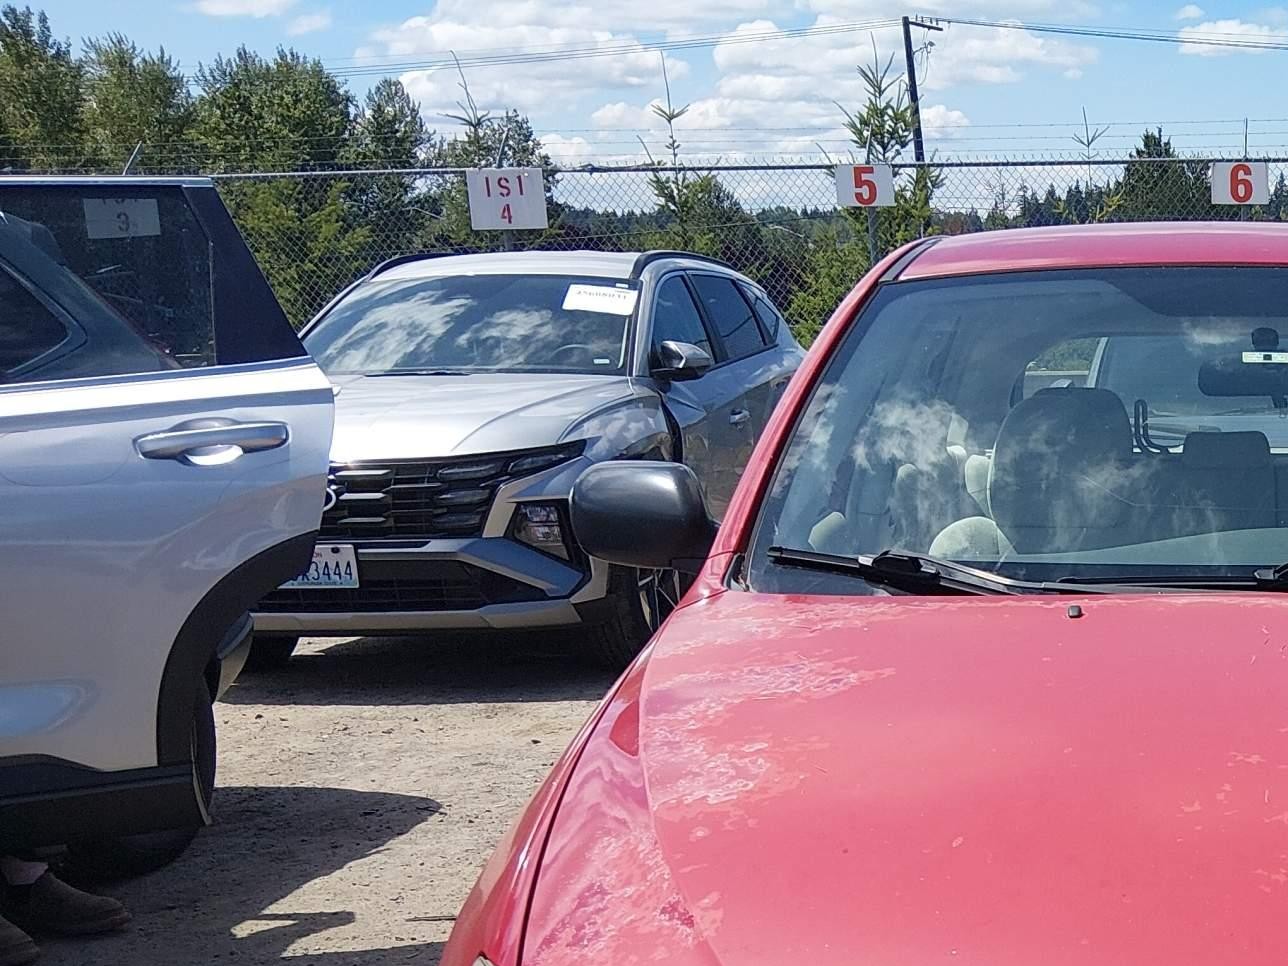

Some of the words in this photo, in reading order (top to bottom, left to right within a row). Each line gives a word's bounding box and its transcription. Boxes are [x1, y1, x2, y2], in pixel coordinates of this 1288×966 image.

[853, 165, 877, 205] 5
[1228, 163, 1253, 203] 6
[500, 203, 512, 224] 4
